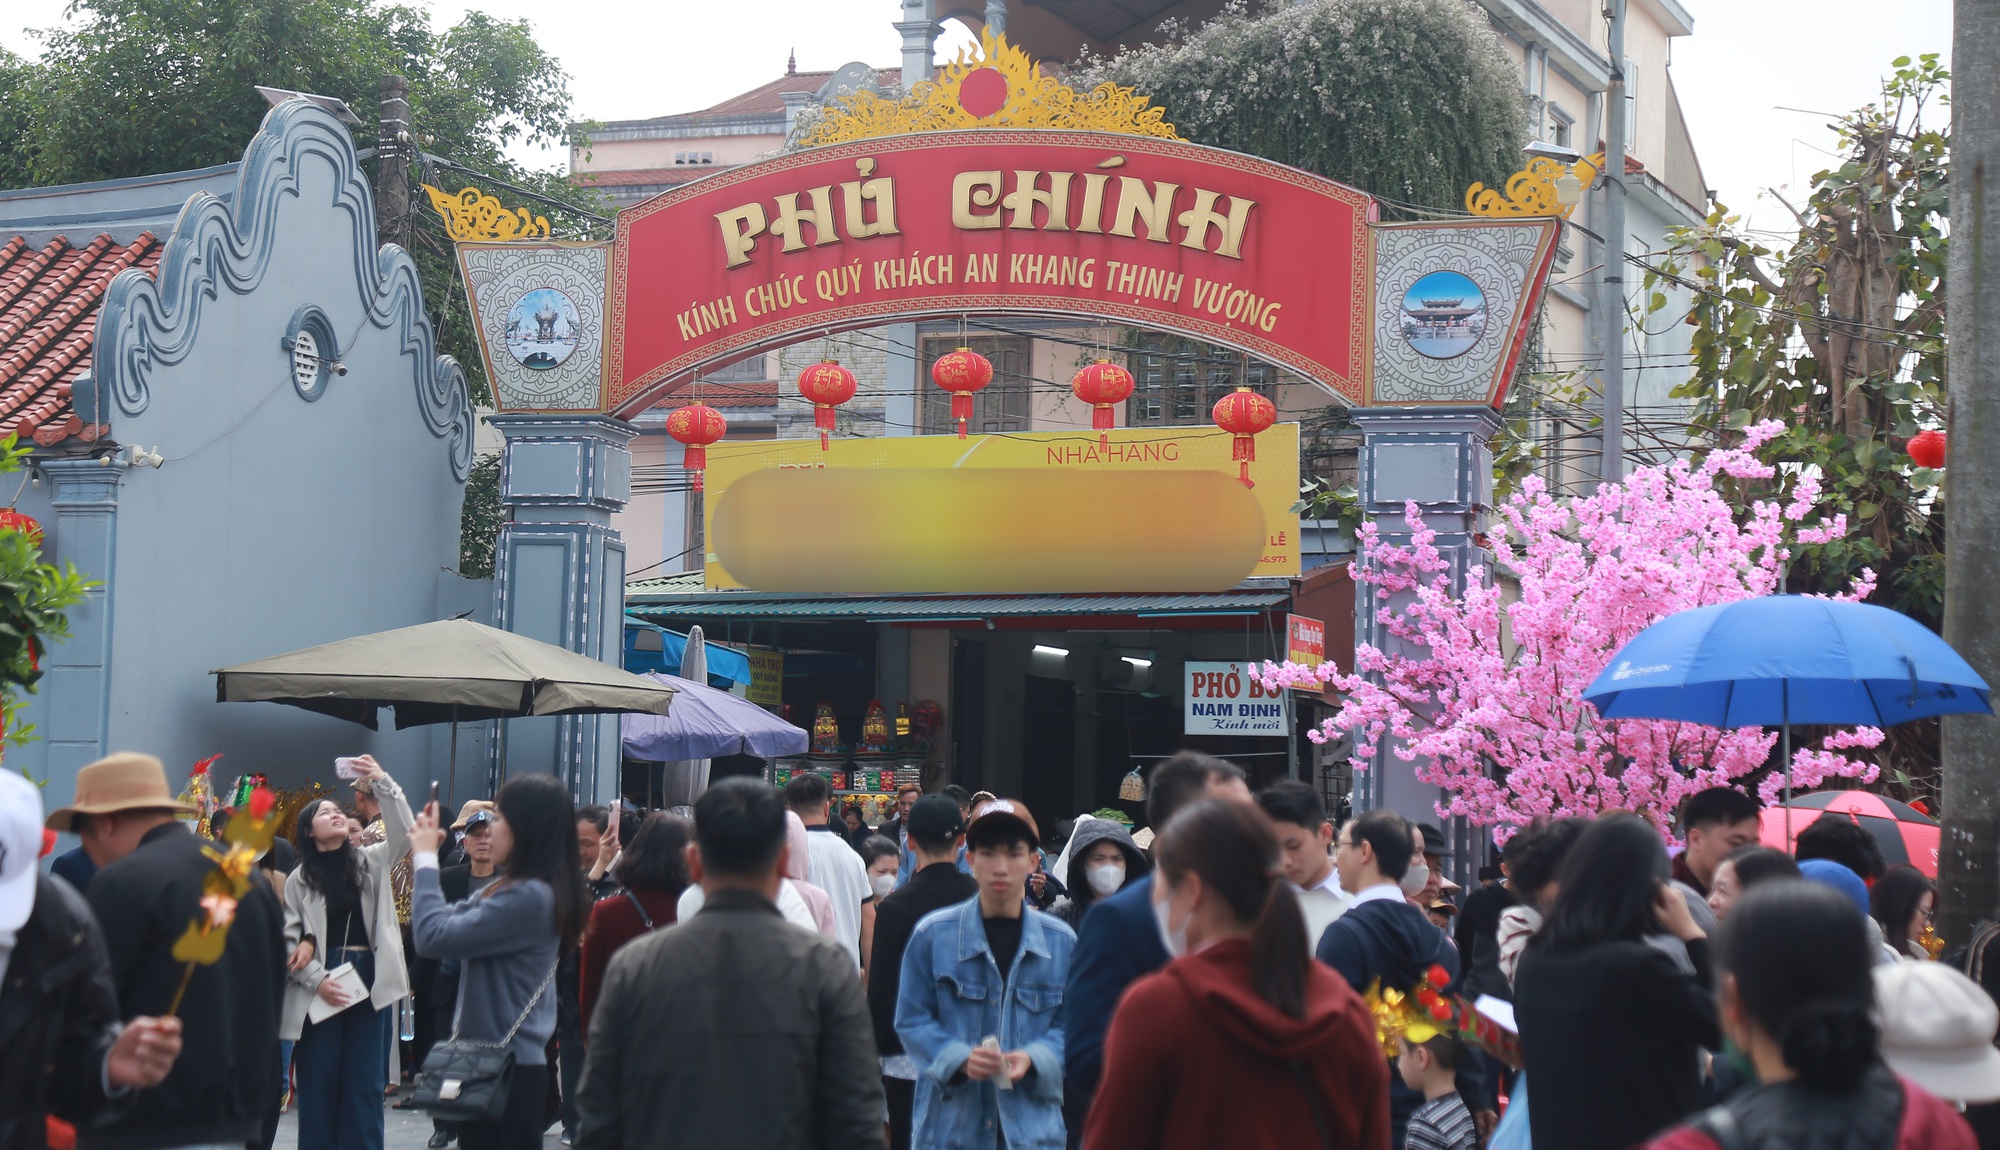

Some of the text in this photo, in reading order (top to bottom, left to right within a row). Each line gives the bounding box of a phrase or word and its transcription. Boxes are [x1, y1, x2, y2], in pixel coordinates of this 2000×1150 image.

[713, 154, 1259, 269] PHỦ CHÍNH
[676, 249, 1282, 342] KÍNH CHÚC QUÝ KHÁCH AN KHANG THỊNH VƯỢNG
[1047, 440, 1179, 465] NHÀ HÀNG
[1270, 531, 1287, 546] LỄ
[1258, 555, 1288, 563] 46.973
[1191, 663, 1242, 699] PHỞ
[1192, 703, 1281, 719] NAM ĐỊNH
[1209, 718, 1281, 730] Kính mời
